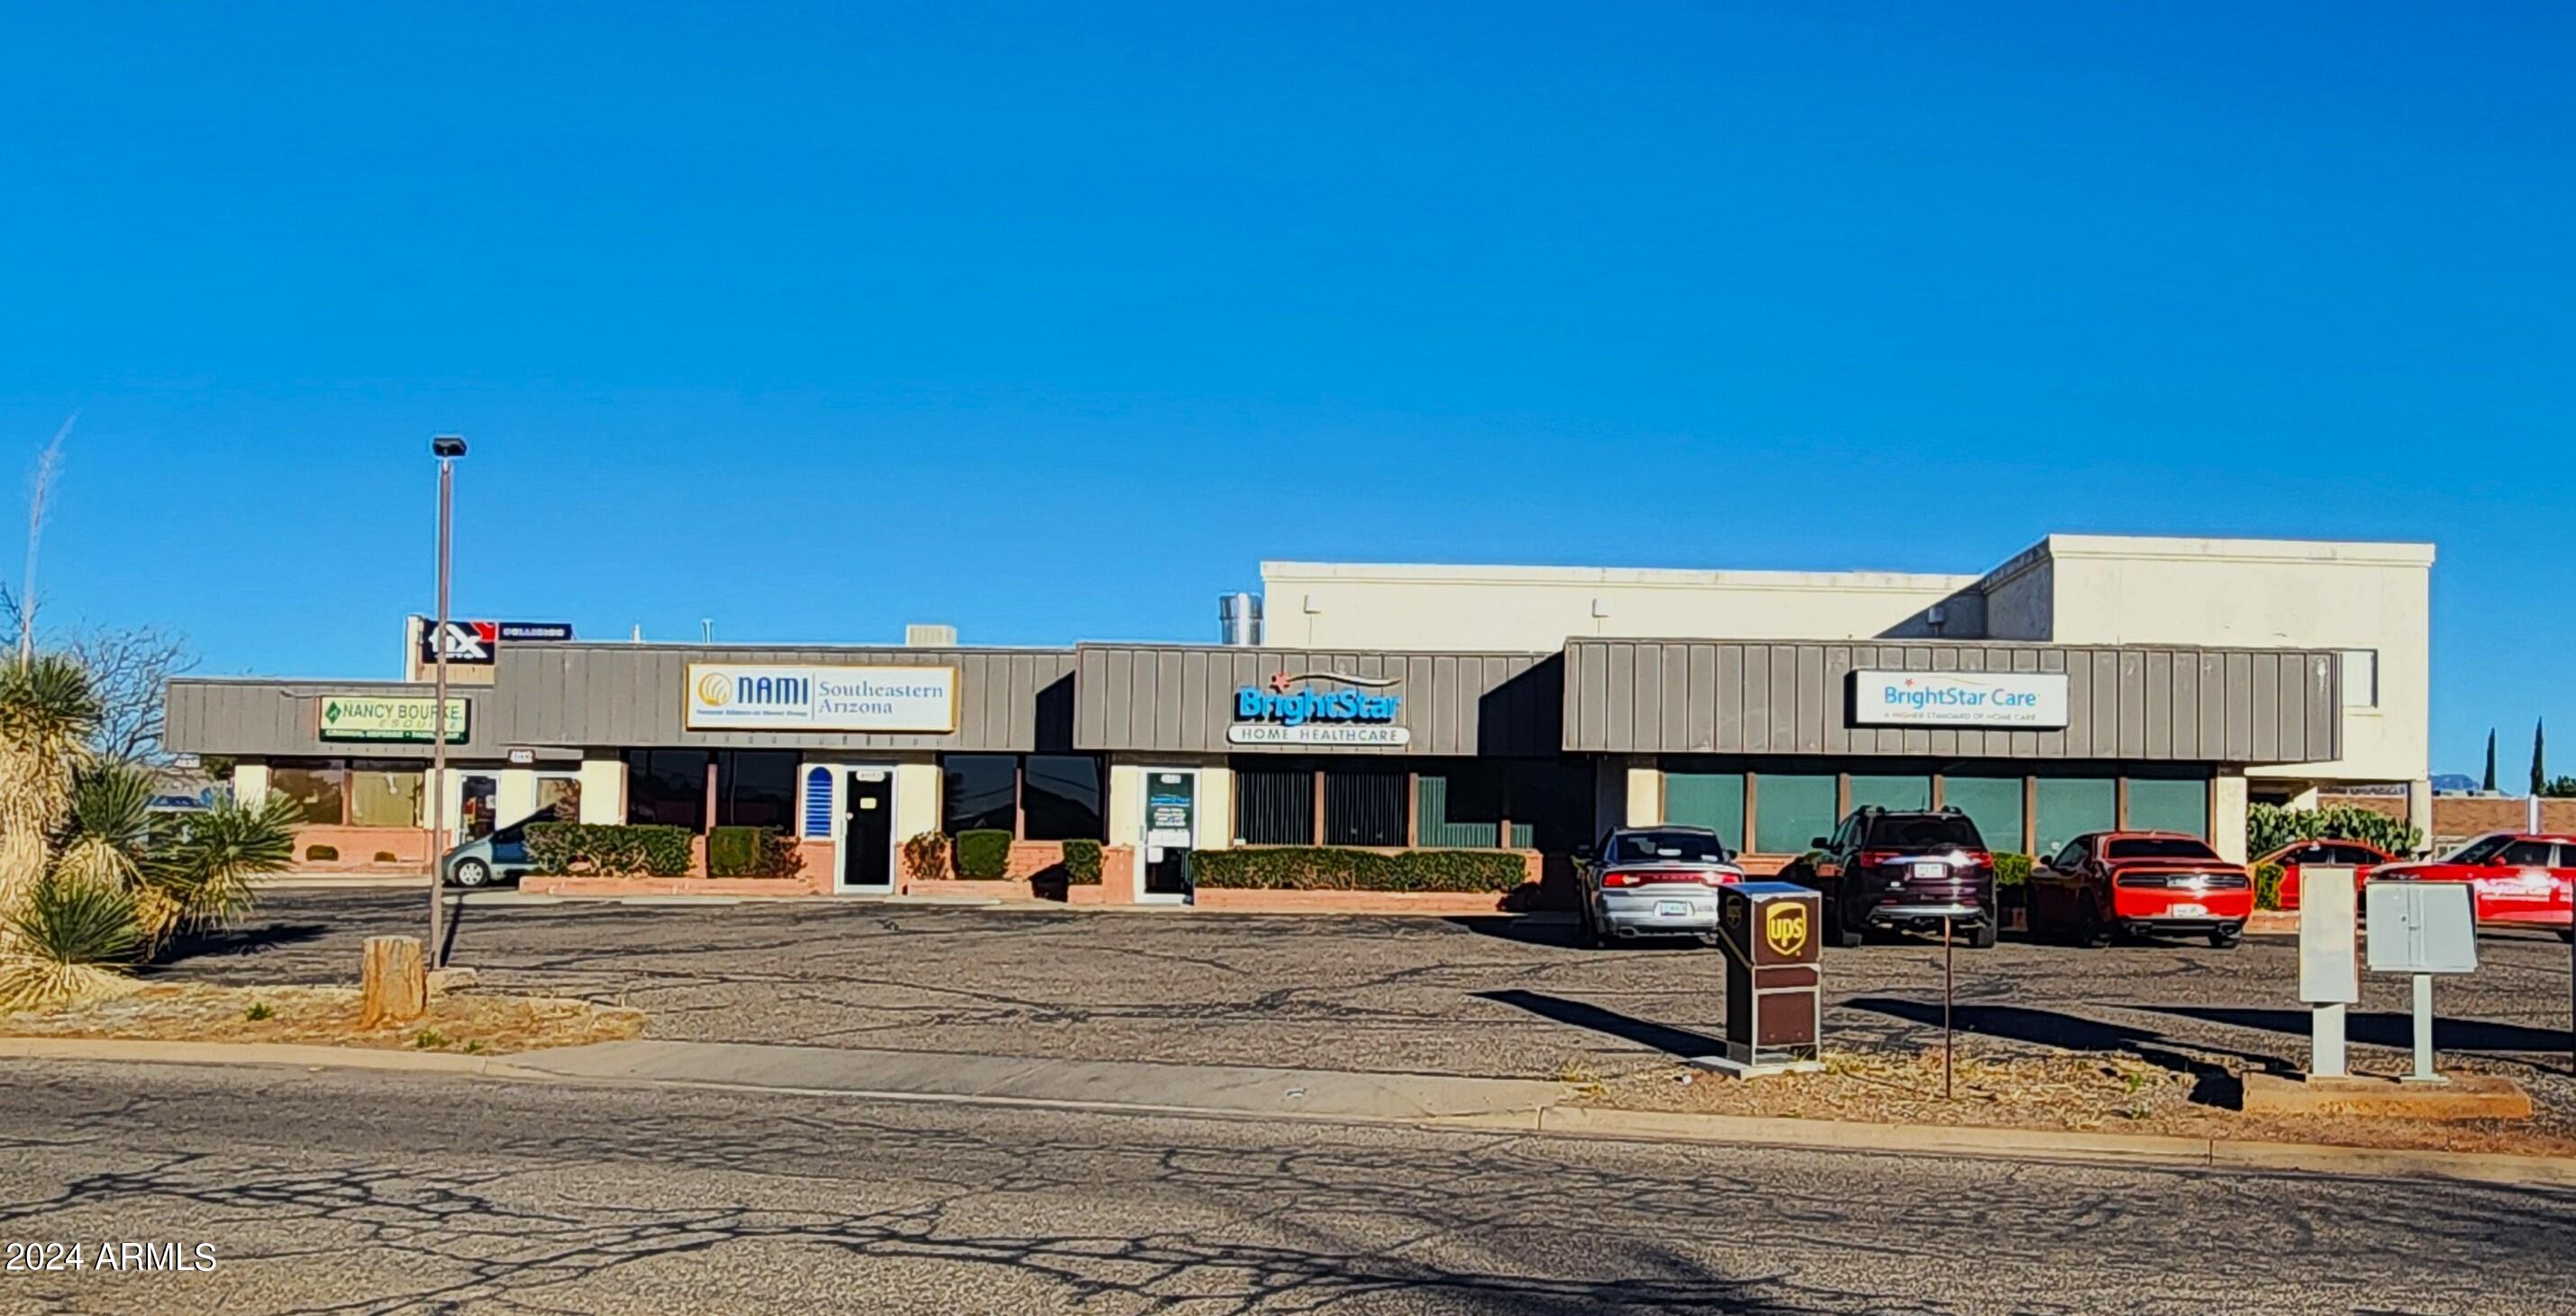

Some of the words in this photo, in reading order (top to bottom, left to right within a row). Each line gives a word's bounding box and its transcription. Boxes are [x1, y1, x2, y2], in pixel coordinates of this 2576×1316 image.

[737, 676, 808, 704] NAMI
[818, 681, 943, 698] Southeastern
[1884, 686, 1988, 709] BrightStar
[1991, 688, 2037, 706] Care
[342, 703, 393, 718] NANCY
[818, 699, 894, 714] Arizona
[1239, 687, 1402, 726] BrightStar
[1242, 728, 1289, 740] HOME
[1300, 728, 1397, 742] HEALTHCARE
